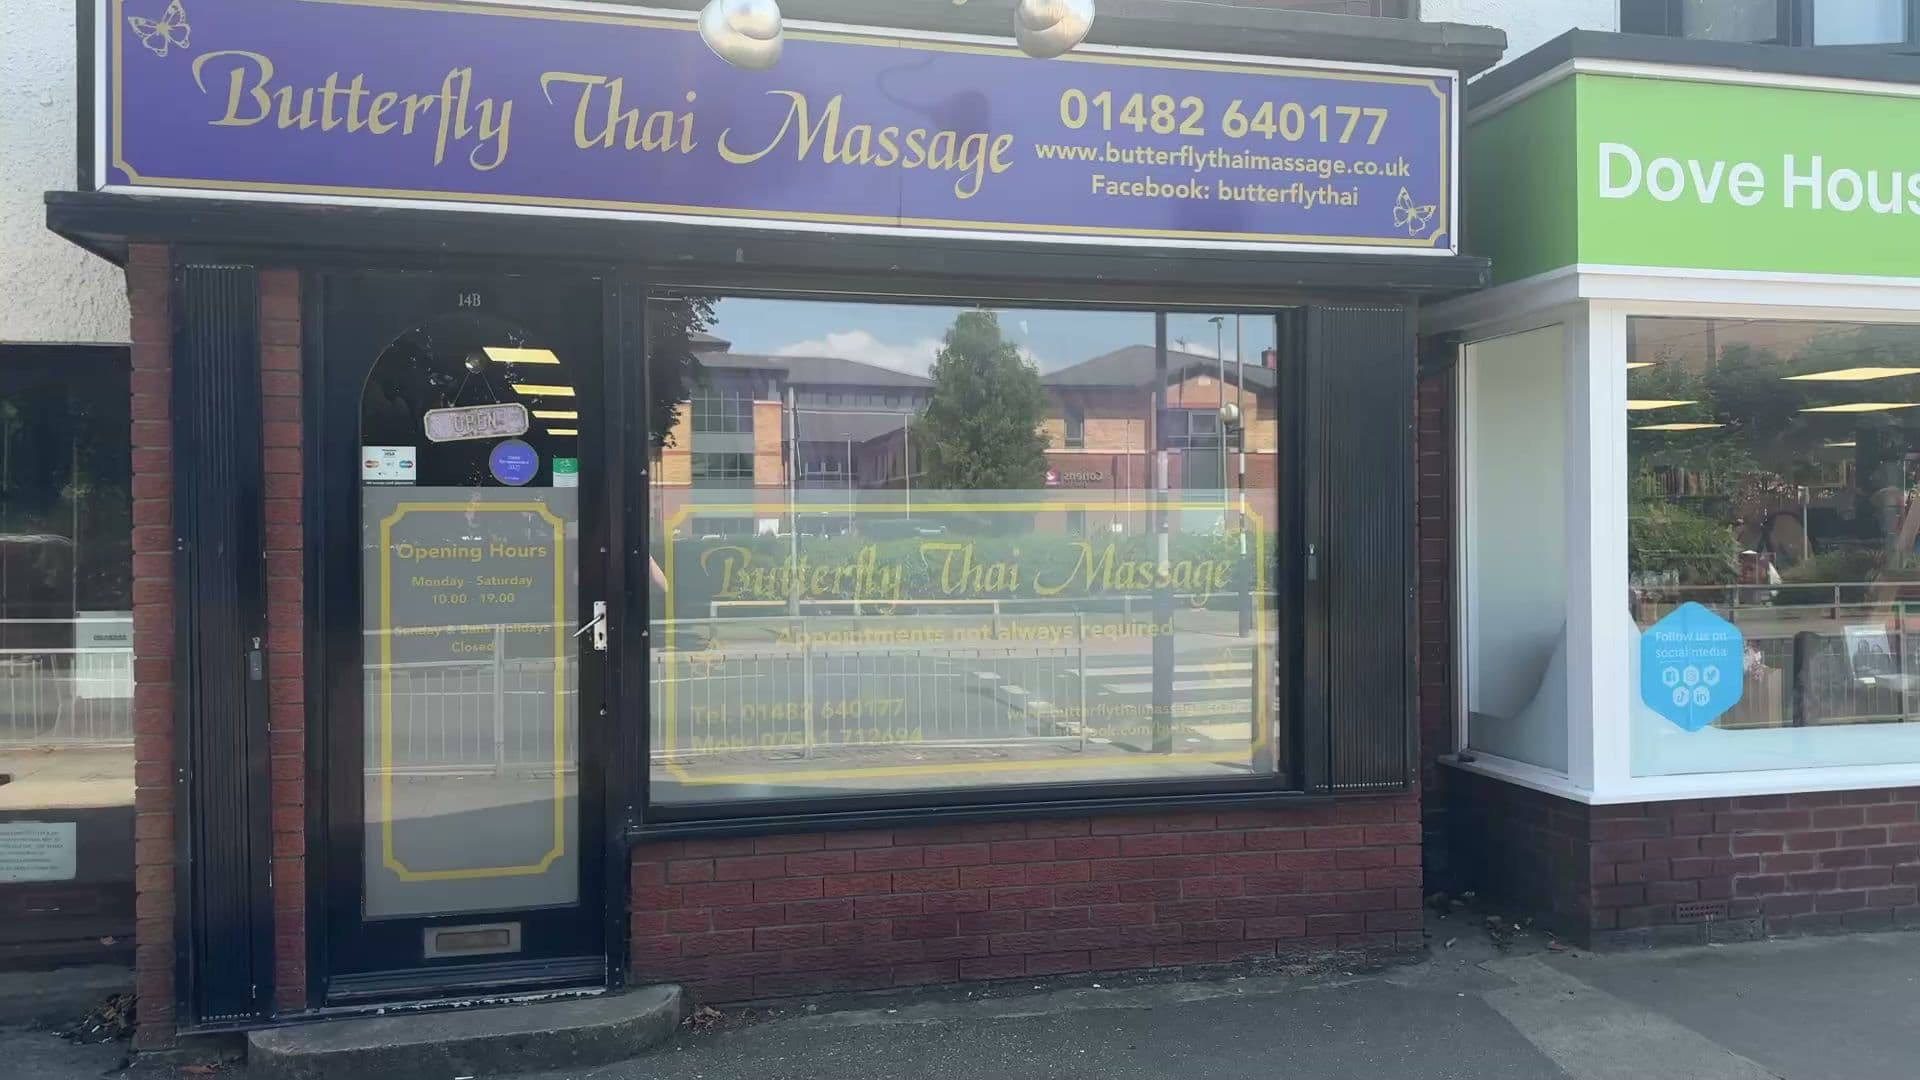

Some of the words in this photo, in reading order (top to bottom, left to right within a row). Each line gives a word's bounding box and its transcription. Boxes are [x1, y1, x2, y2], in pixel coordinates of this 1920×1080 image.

[191, 50, 513, 171] Butterfly
[540, 71, 698, 155] Thai
[717, 90, 1015, 199] Massage
[1059, 87, 1206, 138] 01482
[1221, 100, 1390, 146] 640177
[1035, 139, 1412, 179] www.butterflythaimassage.co.uk
[1599, 142, 1766, 207] Dove
[1091, 173, 1211, 201] Facebook:
[1217, 181, 1360, 208] butterflythai
[458, 293, 482, 307] 14B
[452, 411, 499, 433] OPEN
[398, 542, 483, 563] Opening
[489, 542, 548, 559] Hours
[411, 576, 465, 589] Monday
[476, 575, 534, 588] Saturday
[701, 542, 904, 614] Butterfly
[920, 541, 1020, 594] Thai
[1032, 540, 1233, 609] Massage
[432, 593, 467, 605] 10.00
[480, 592, 515, 604] 19.00
[951, 625, 990, 641] not
[998, 620, 1073, 645] always
[1080, 617, 1174, 643] required
[1655, 631, 1694, 642] Follow
[1696, 632, 1711, 642] us
[1712, 632, 1728, 642] on
[451, 640, 497, 653] Closed
[1655, 647, 1689, 658] social
[1691, 647, 1729, 657] media
